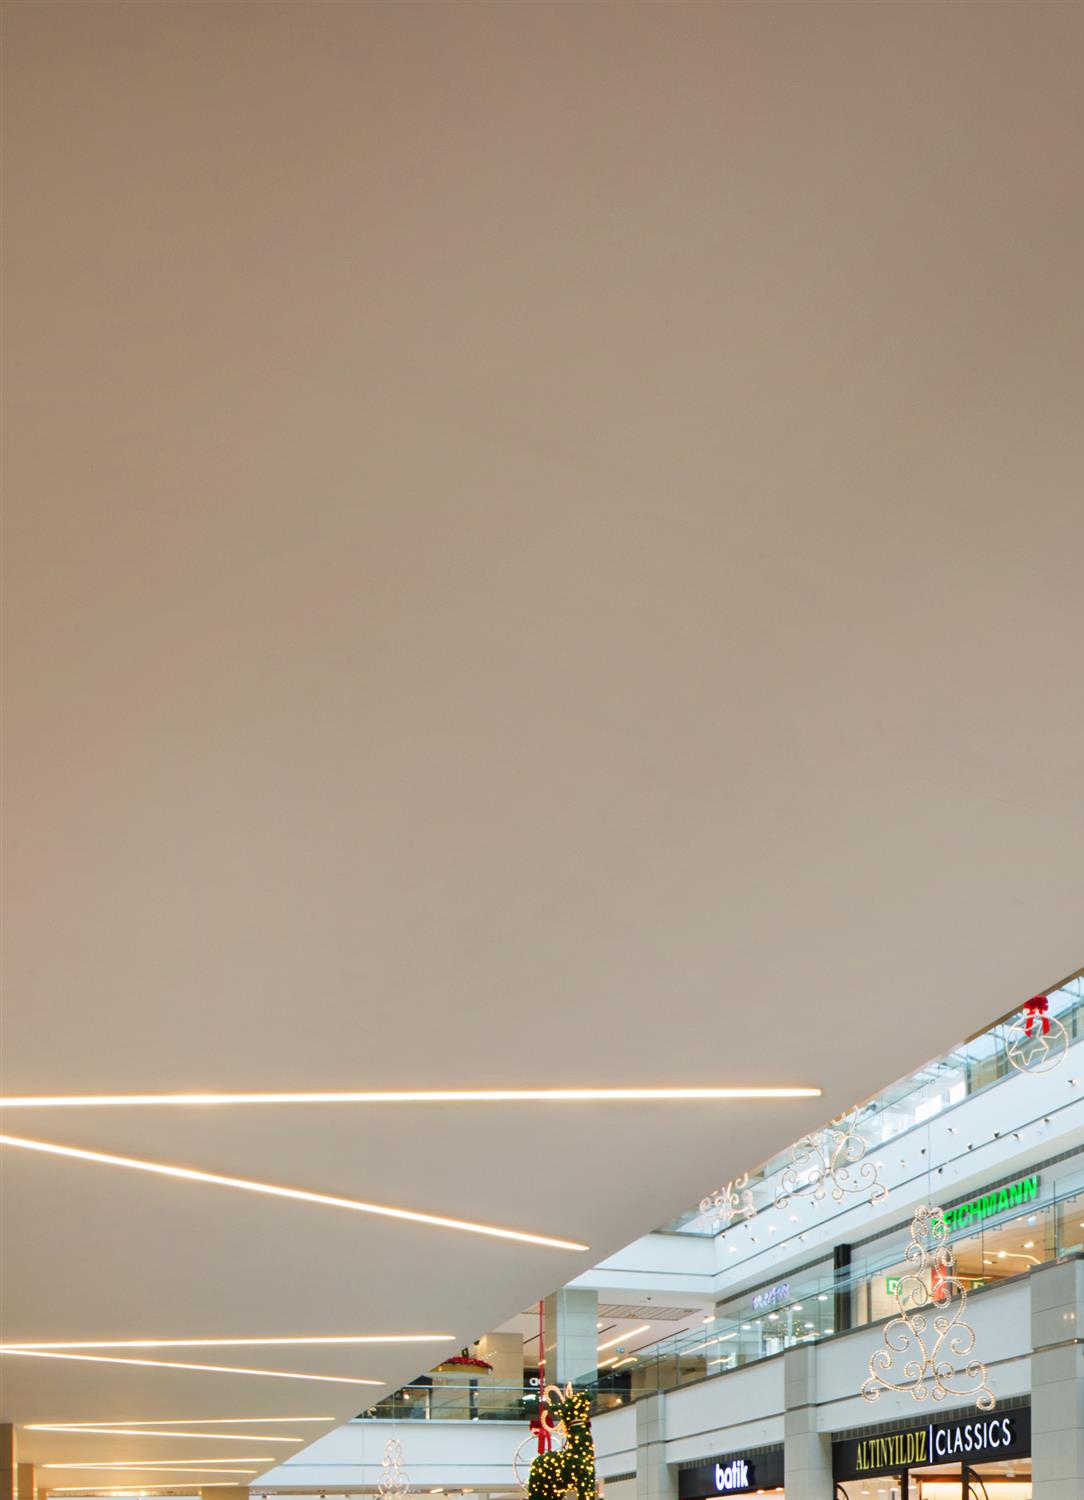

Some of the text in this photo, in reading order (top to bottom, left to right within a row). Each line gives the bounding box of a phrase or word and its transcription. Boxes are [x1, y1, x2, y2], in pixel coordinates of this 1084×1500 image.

[856, 1418, 1012, 1471] ALTINYILDIZ CLASSICS
[715, 1459, 750, 1491] batik
